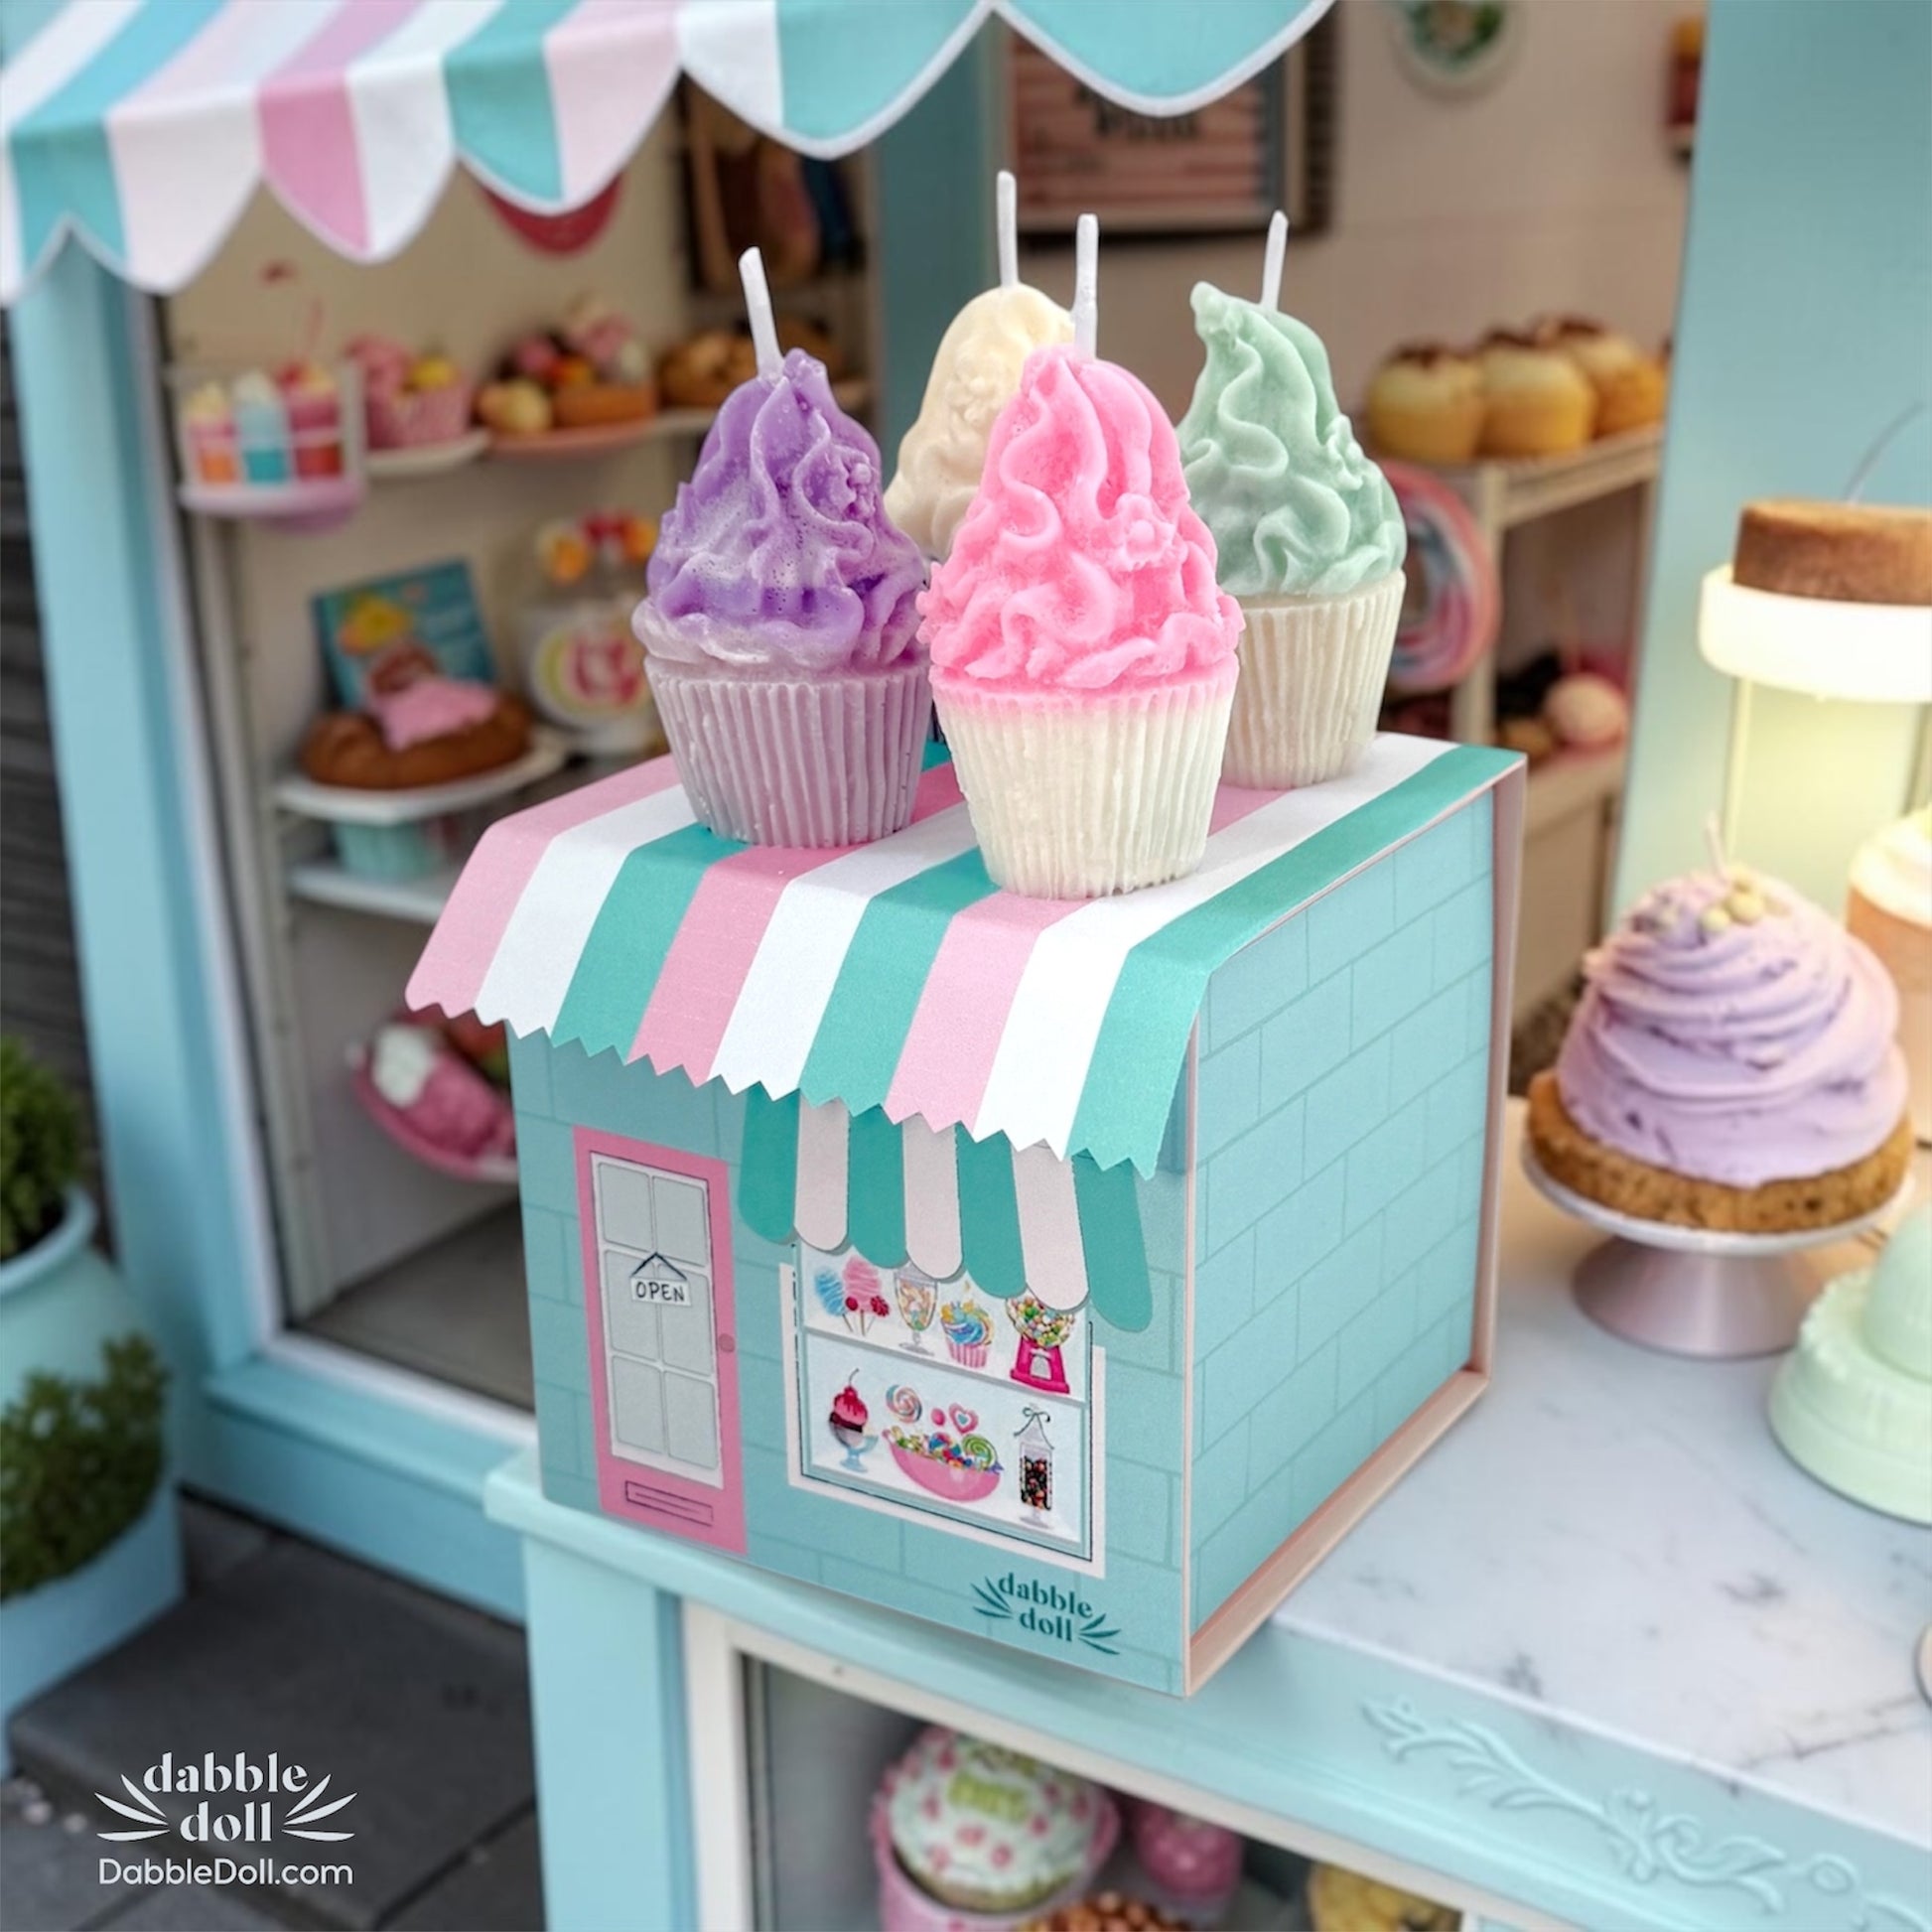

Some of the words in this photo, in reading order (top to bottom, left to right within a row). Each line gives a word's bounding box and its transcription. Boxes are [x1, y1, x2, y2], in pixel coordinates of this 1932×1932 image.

[635, 1281, 685, 1303] OPEN
[998, 1572, 1094, 1619] dabble
[1019, 1606, 1073, 1643] doll
